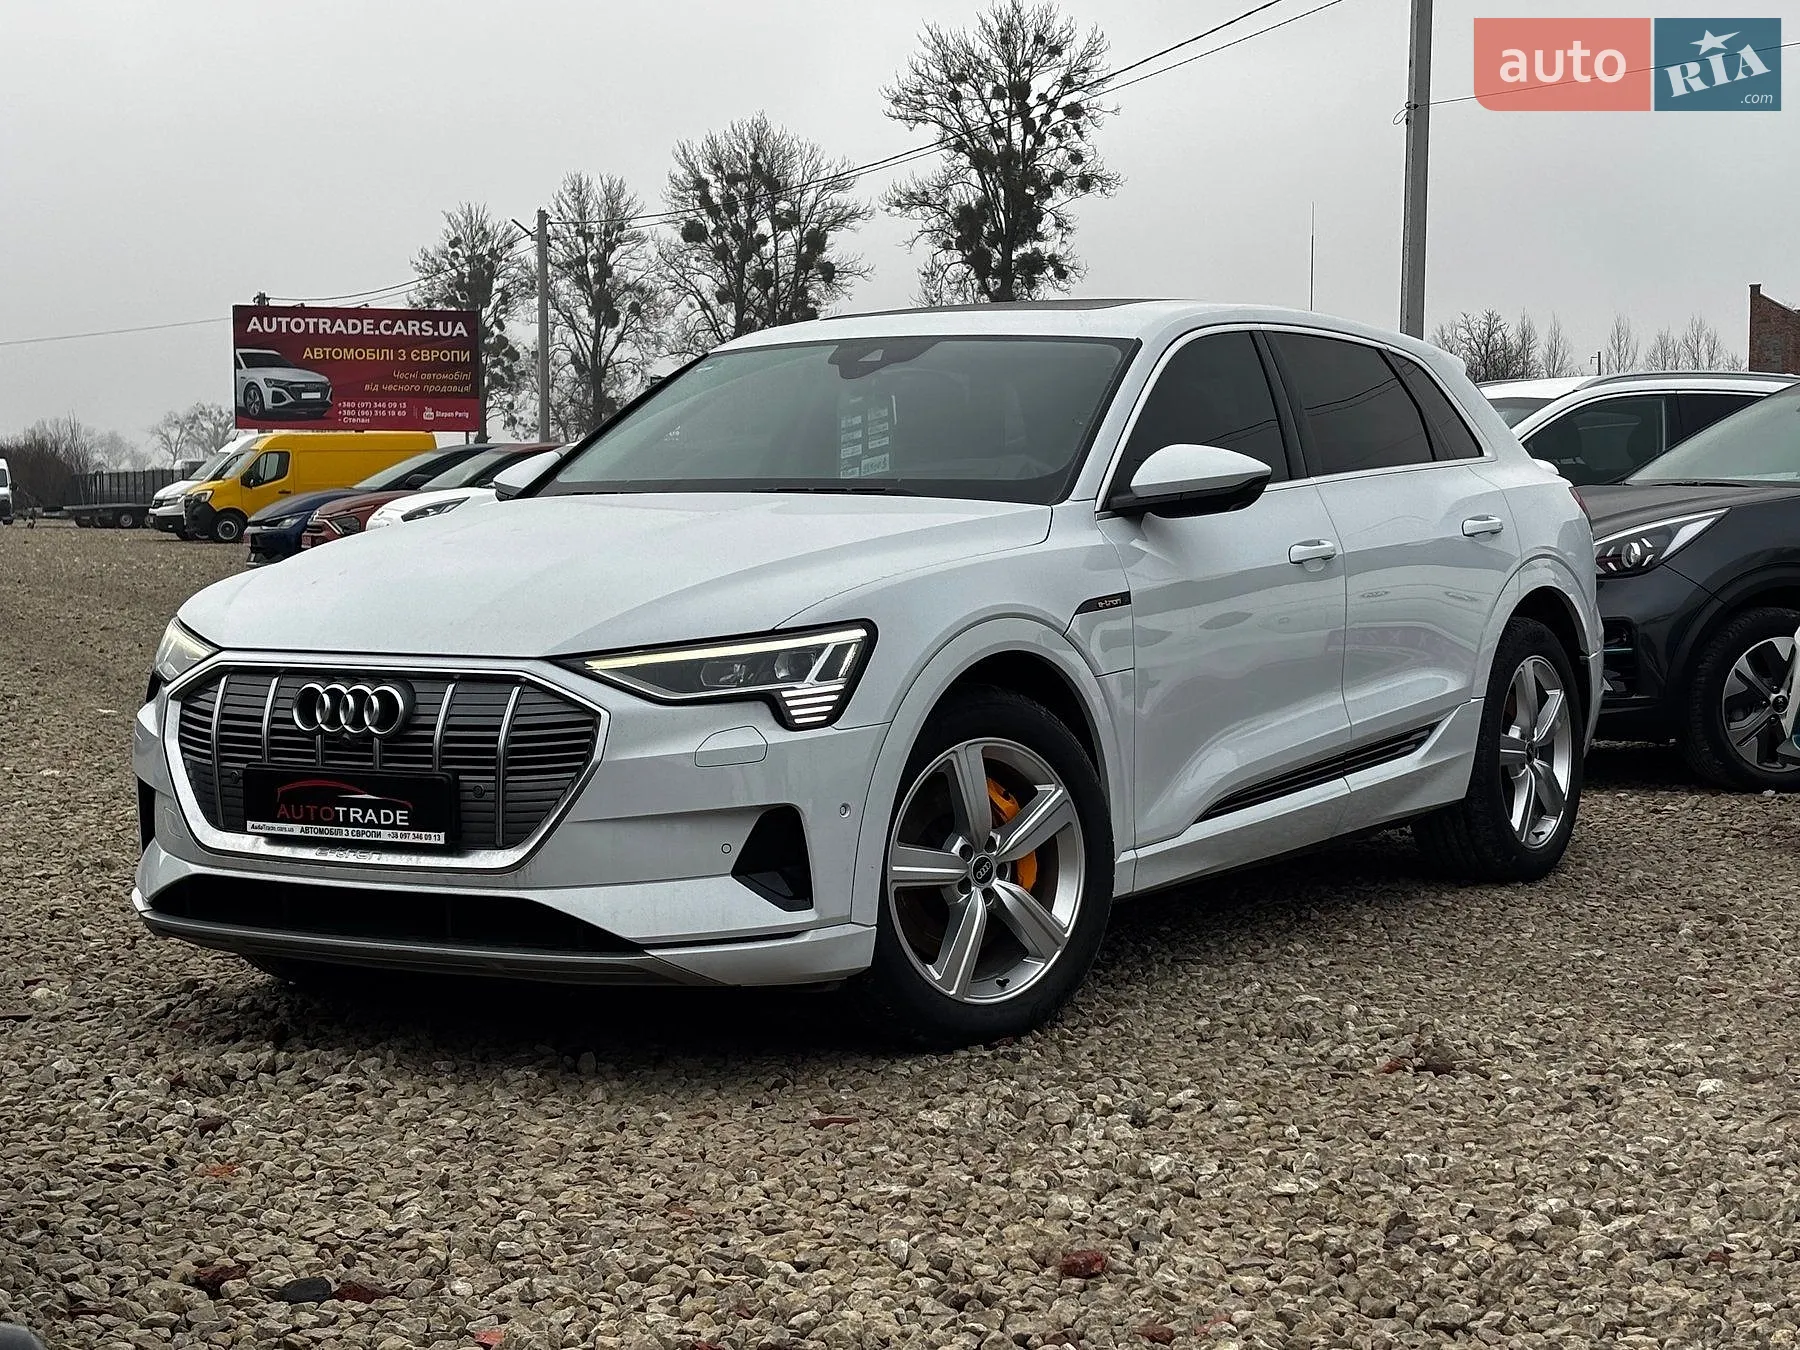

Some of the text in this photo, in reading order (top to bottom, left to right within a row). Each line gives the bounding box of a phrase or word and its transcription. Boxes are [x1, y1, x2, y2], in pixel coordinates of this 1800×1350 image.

[246, 316, 469, 338] AUTOTRADE.CARS.UA
[302, 347, 394, 361] АВТОМОБІЛІ
[410, 349, 471, 363] ЄВРОПИ
[276, 803, 410, 826] AUTOTRADE
[350, 829, 382, 839] ЄВРОПИ
[433, 833, 441, 841] 13
